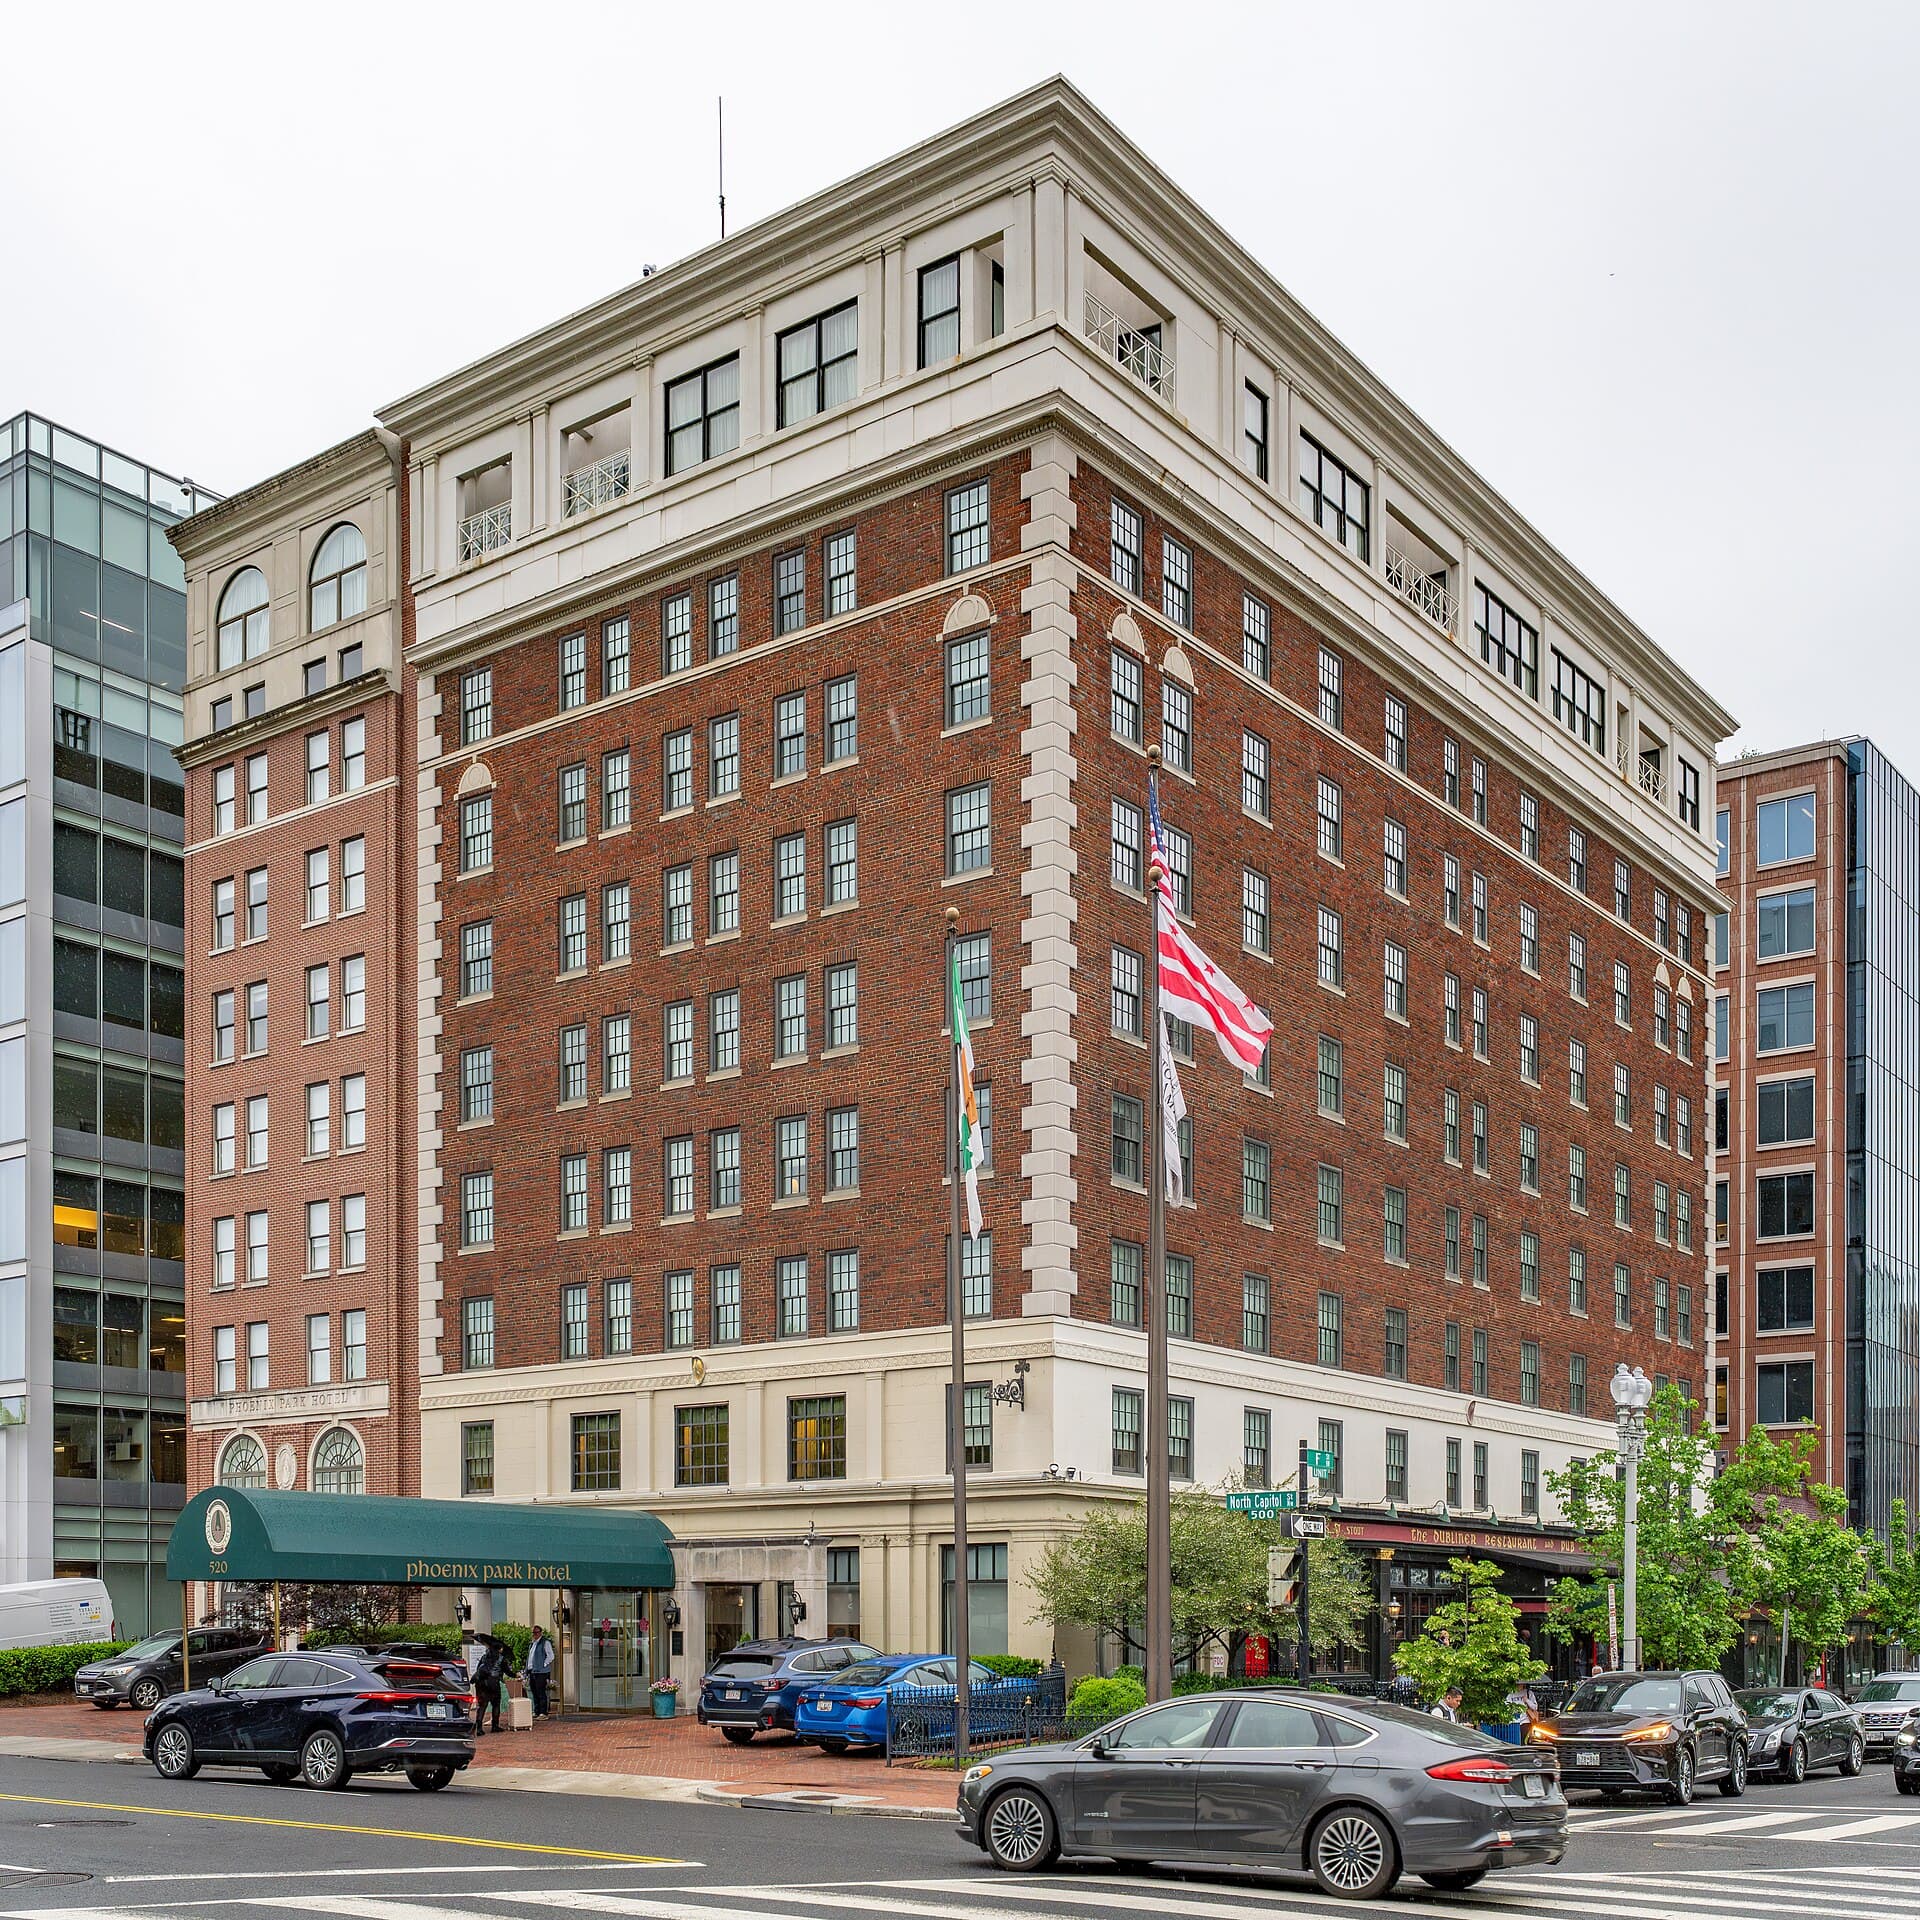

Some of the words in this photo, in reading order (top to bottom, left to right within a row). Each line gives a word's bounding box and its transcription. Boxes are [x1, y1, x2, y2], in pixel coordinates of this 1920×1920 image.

[229, 1399, 275, 1414] PHOENIX
[279, 1396, 306, 1410] PARK
[311, 1392, 347, 1406] HOTEL
[1315, 1452, 1321, 1467] F
[1313, 1467, 1328, 1479] UNIT
[1230, 1494, 1251, 1509] North
[1254, 1492, 1282, 1509] Capitol
[1251, 1510, 1274, 1519] 500
[1303, 1521, 1312, 1532] ONE
[1313, 1523, 1323, 1533] WAY
[209, 1561, 228, 1574] 520
[406, 1560, 479, 1582] phoenix
[483, 1562, 523, 1583] park
[527, 1563, 572, 1581] hotel
